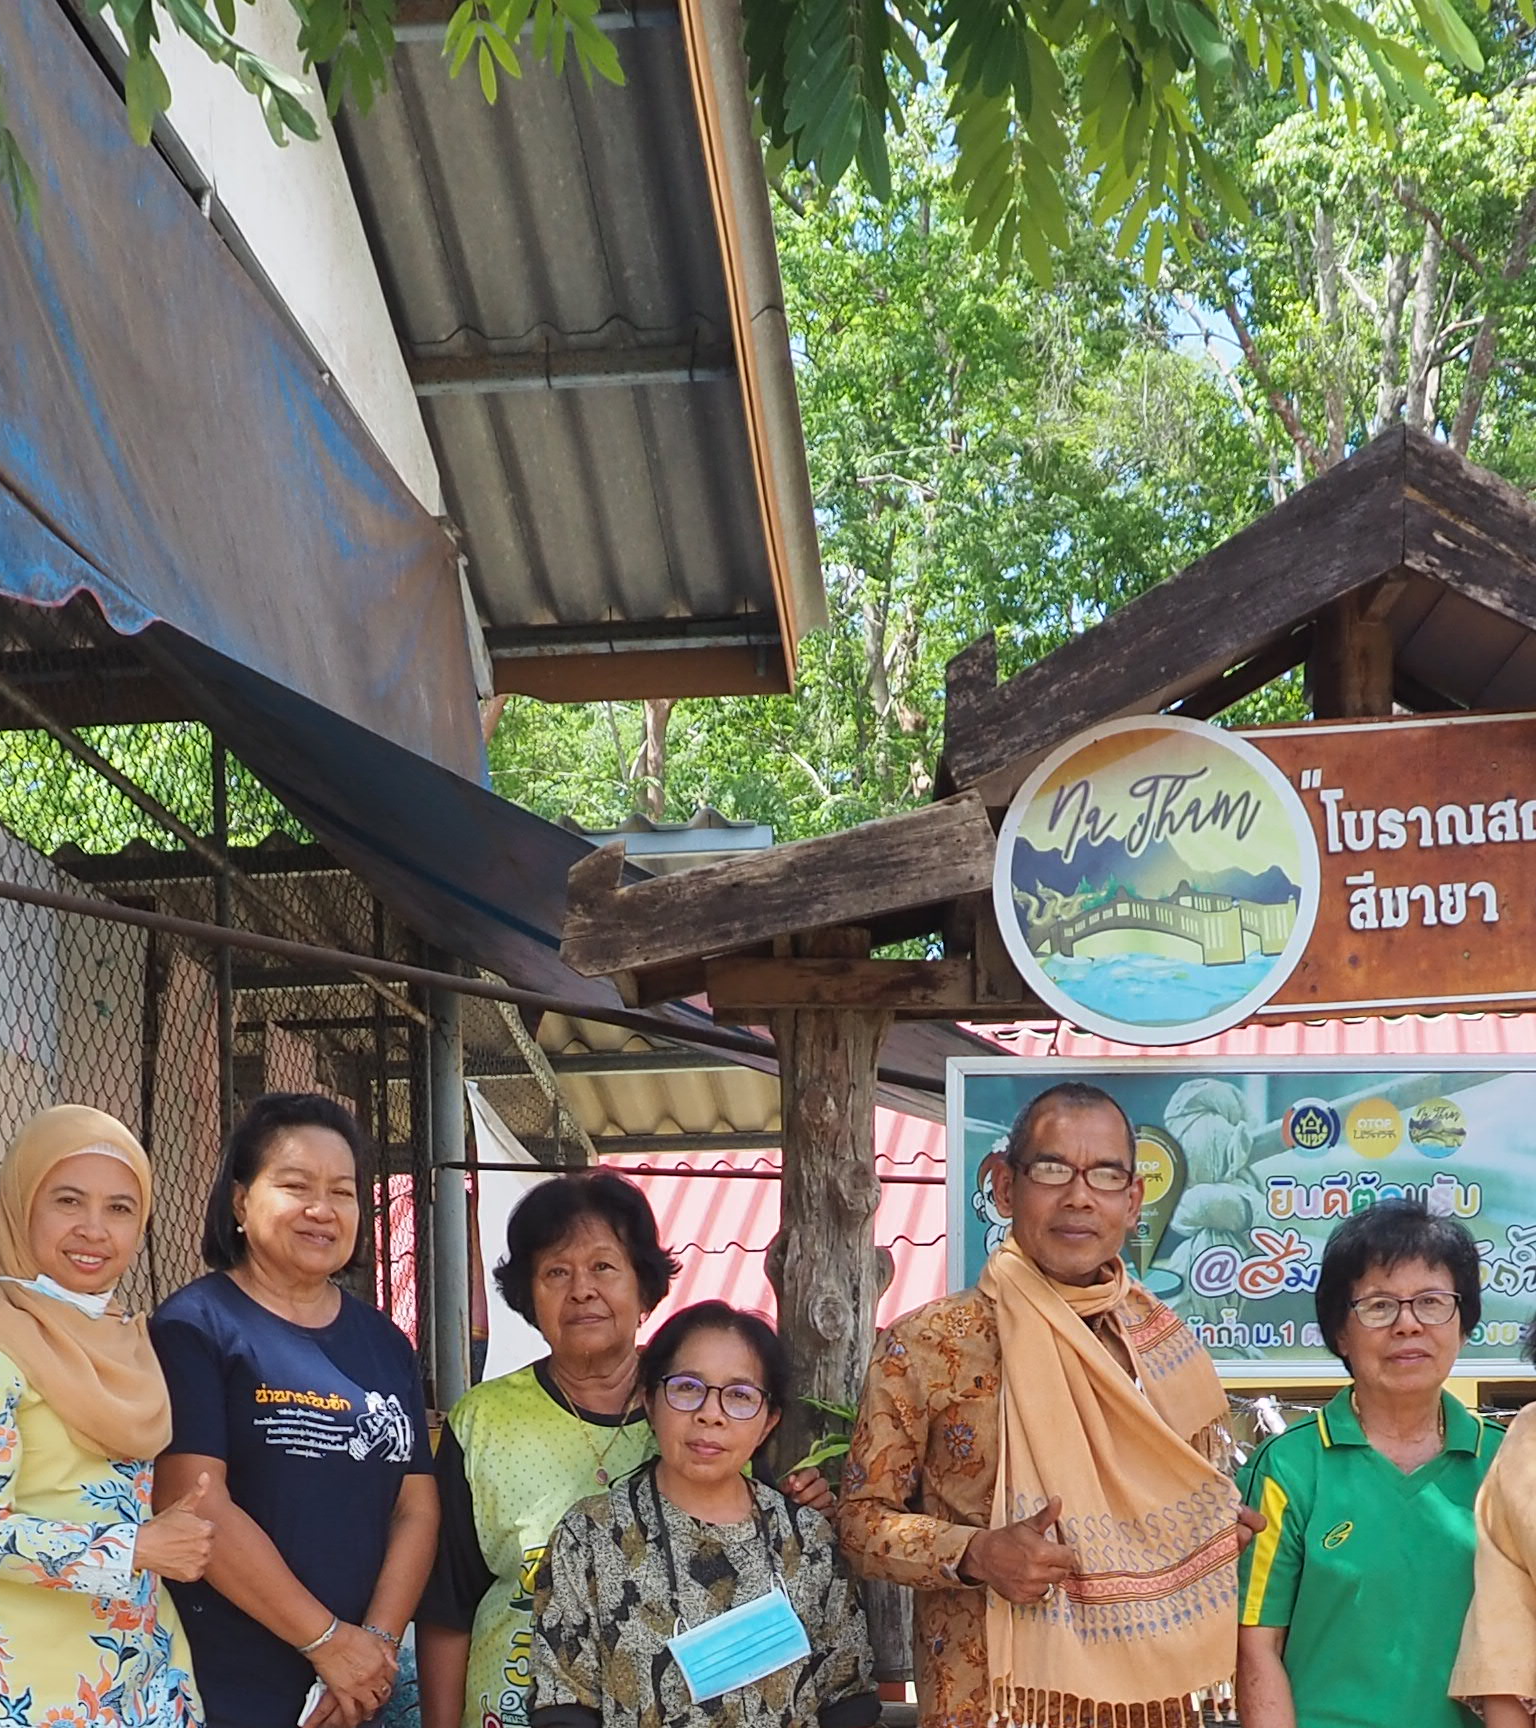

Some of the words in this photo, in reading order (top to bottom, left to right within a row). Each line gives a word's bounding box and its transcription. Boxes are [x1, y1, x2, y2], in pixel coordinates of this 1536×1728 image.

[1047, 778, 1118, 861] Na
[1126, 765, 1262, 854] Tham
[1135, 1161, 1160, 1172] TOP
